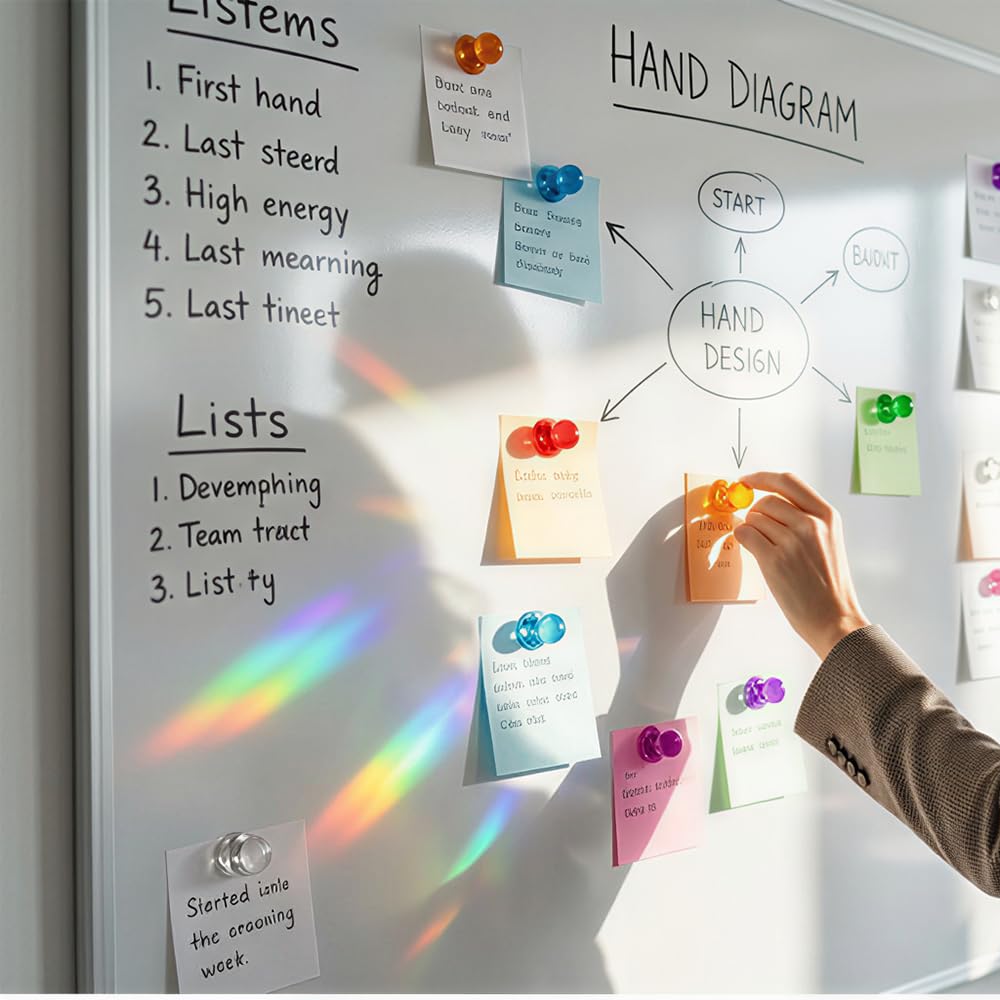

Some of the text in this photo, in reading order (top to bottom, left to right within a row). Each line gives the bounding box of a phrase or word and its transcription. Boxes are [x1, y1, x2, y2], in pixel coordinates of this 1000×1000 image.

[178, 64, 241, 104] First
[256, 77, 322, 118] hand
[610, 23, 858, 142] HAND DIAGRAM
[142, 119, 339, 175] 2. Last steerd
[144, 174, 348, 239] 3. High energy
[713, 188, 765, 216] START
[143, 229, 384, 297] 4. Last mearning
[145, 287, 340, 328] 5. Last tineet
[700, 300, 765, 334] HAND
[704, 342, 780, 375] DESIGN
[177, 393, 288, 438] Lists
[179, 472, 321, 509] Devemphing
[150, 527, 171, 552] 2.
[178, 521, 242, 548] Team
[150, 575, 173, 603] 3.
[187, 883, 250, 918] Started
[190, 930, 220, 950] the
